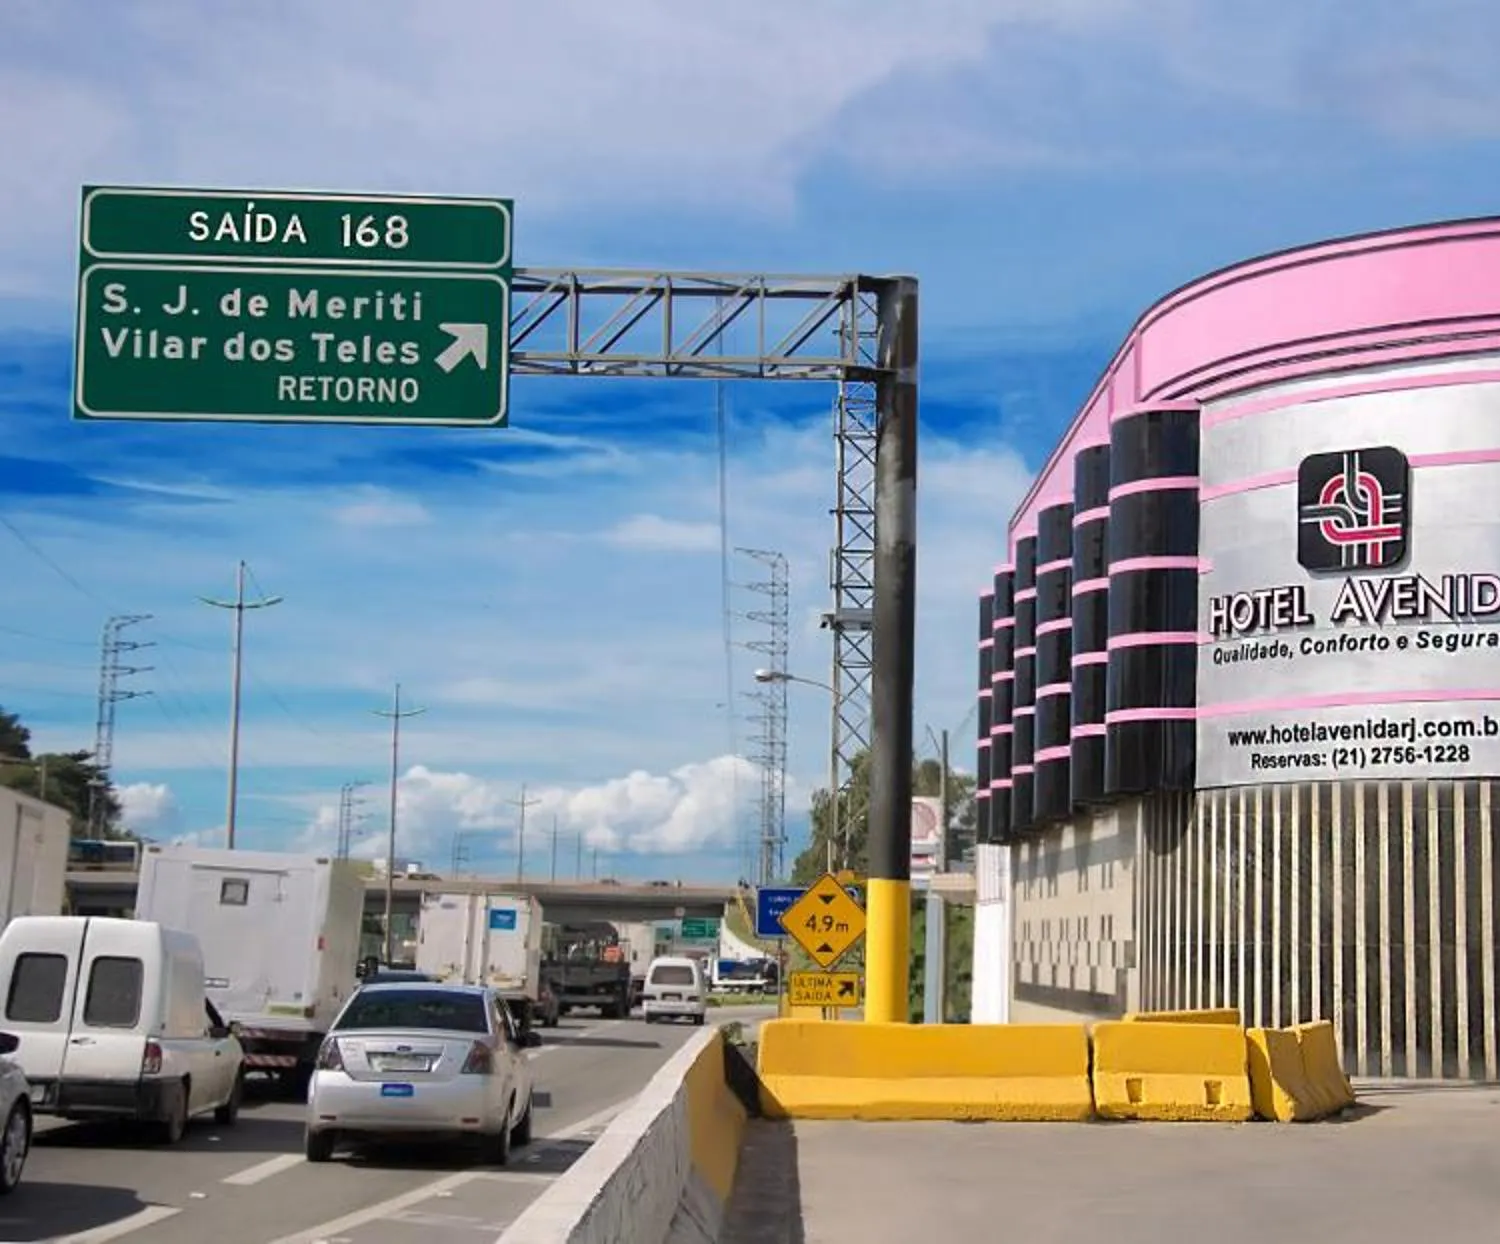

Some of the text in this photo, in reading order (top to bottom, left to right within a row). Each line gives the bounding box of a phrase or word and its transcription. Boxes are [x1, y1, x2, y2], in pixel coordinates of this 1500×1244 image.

[188, 202, 410, 249] SAÍDA 168
[103, 283, 423, 321] S. J. de Meriti
[101, 327, 421, 365] Vilar dos Teles
[278, 375, 420, 403] RETORNO
[1209, 584, 1315, 638] HOTEL
[1213, 641, 1293, 666] Qualidade,
[1301, 633, 1389, 655] Conforto
[1396, 636, 1408, 649] e
[1251, 745, 1471, 769] Reservas: (21) 2756-1228
